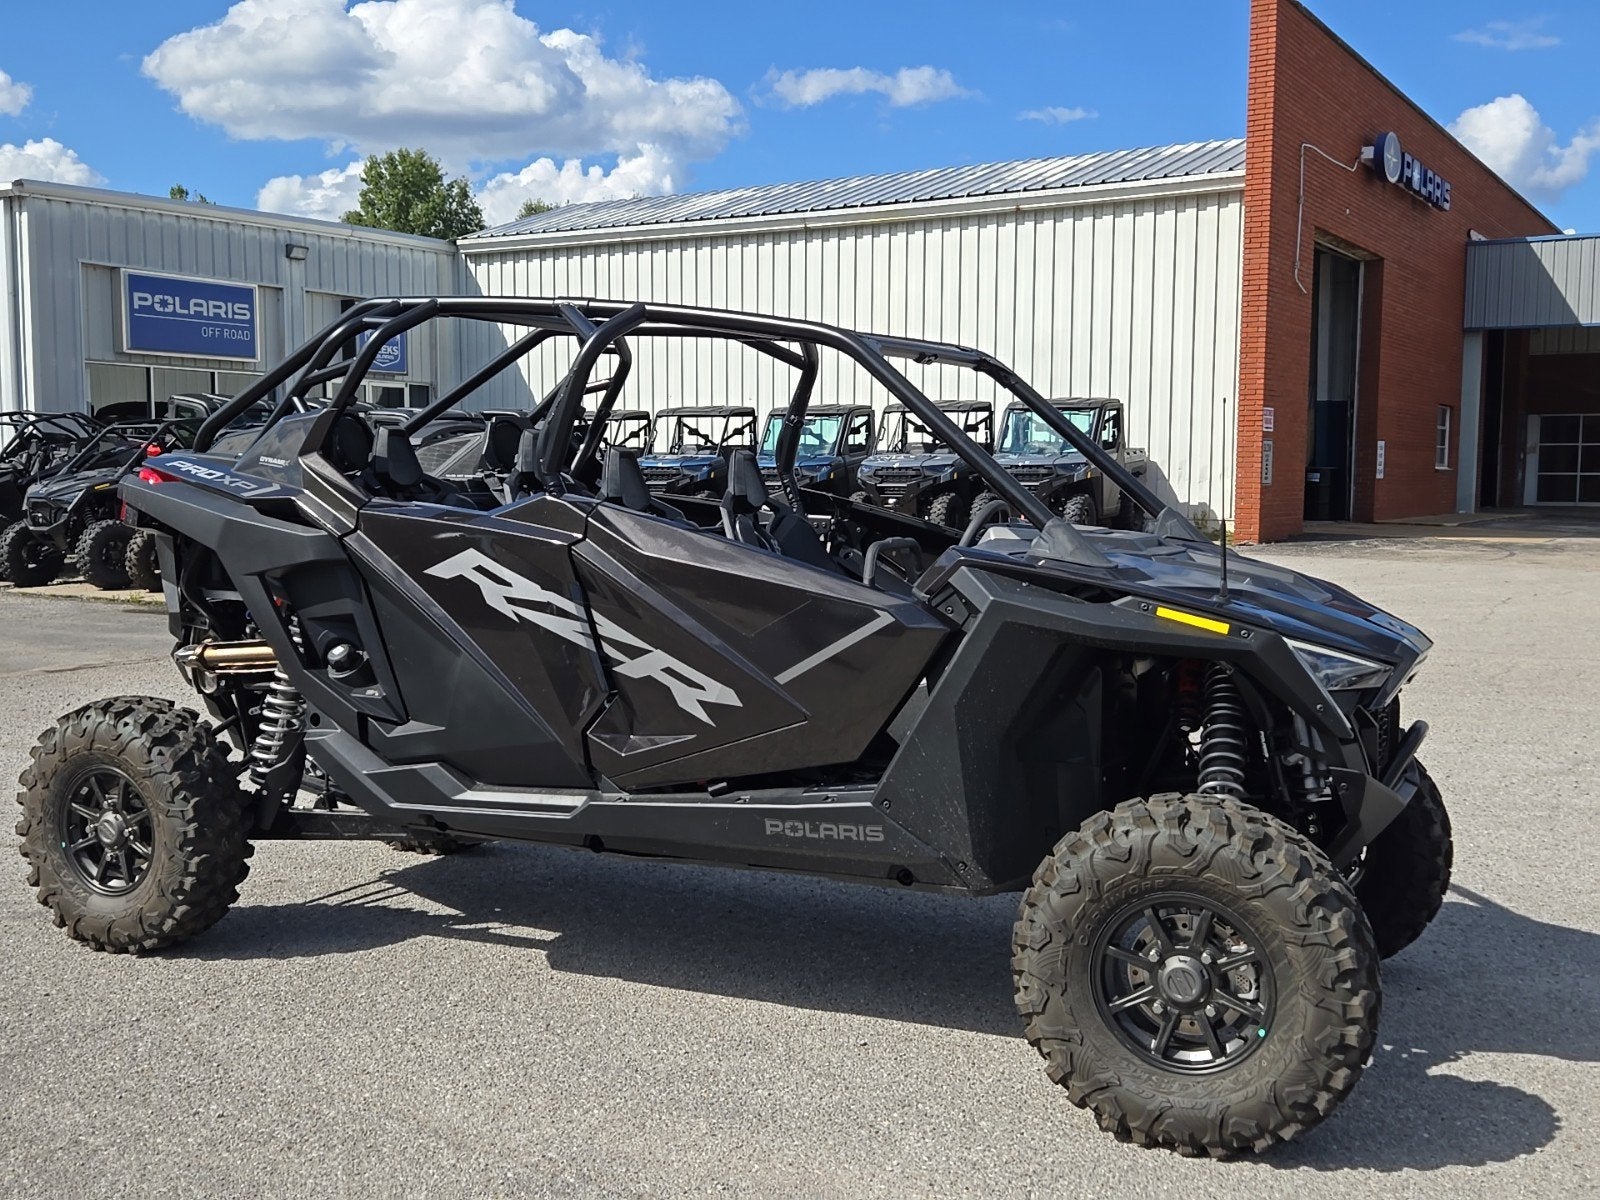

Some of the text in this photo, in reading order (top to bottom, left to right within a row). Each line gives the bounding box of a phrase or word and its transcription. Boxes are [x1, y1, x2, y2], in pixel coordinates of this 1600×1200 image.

[1403, 152, 1451, 211] POLARIS
[133, 291, 251, 320] POLARIS
[201, 326, 251, 341] OFF ROAD
[165, 460, 258, 490] PRO XP
[422, 547, 743, 727] RZR
[765, 818, 884, 842] POLARIS
